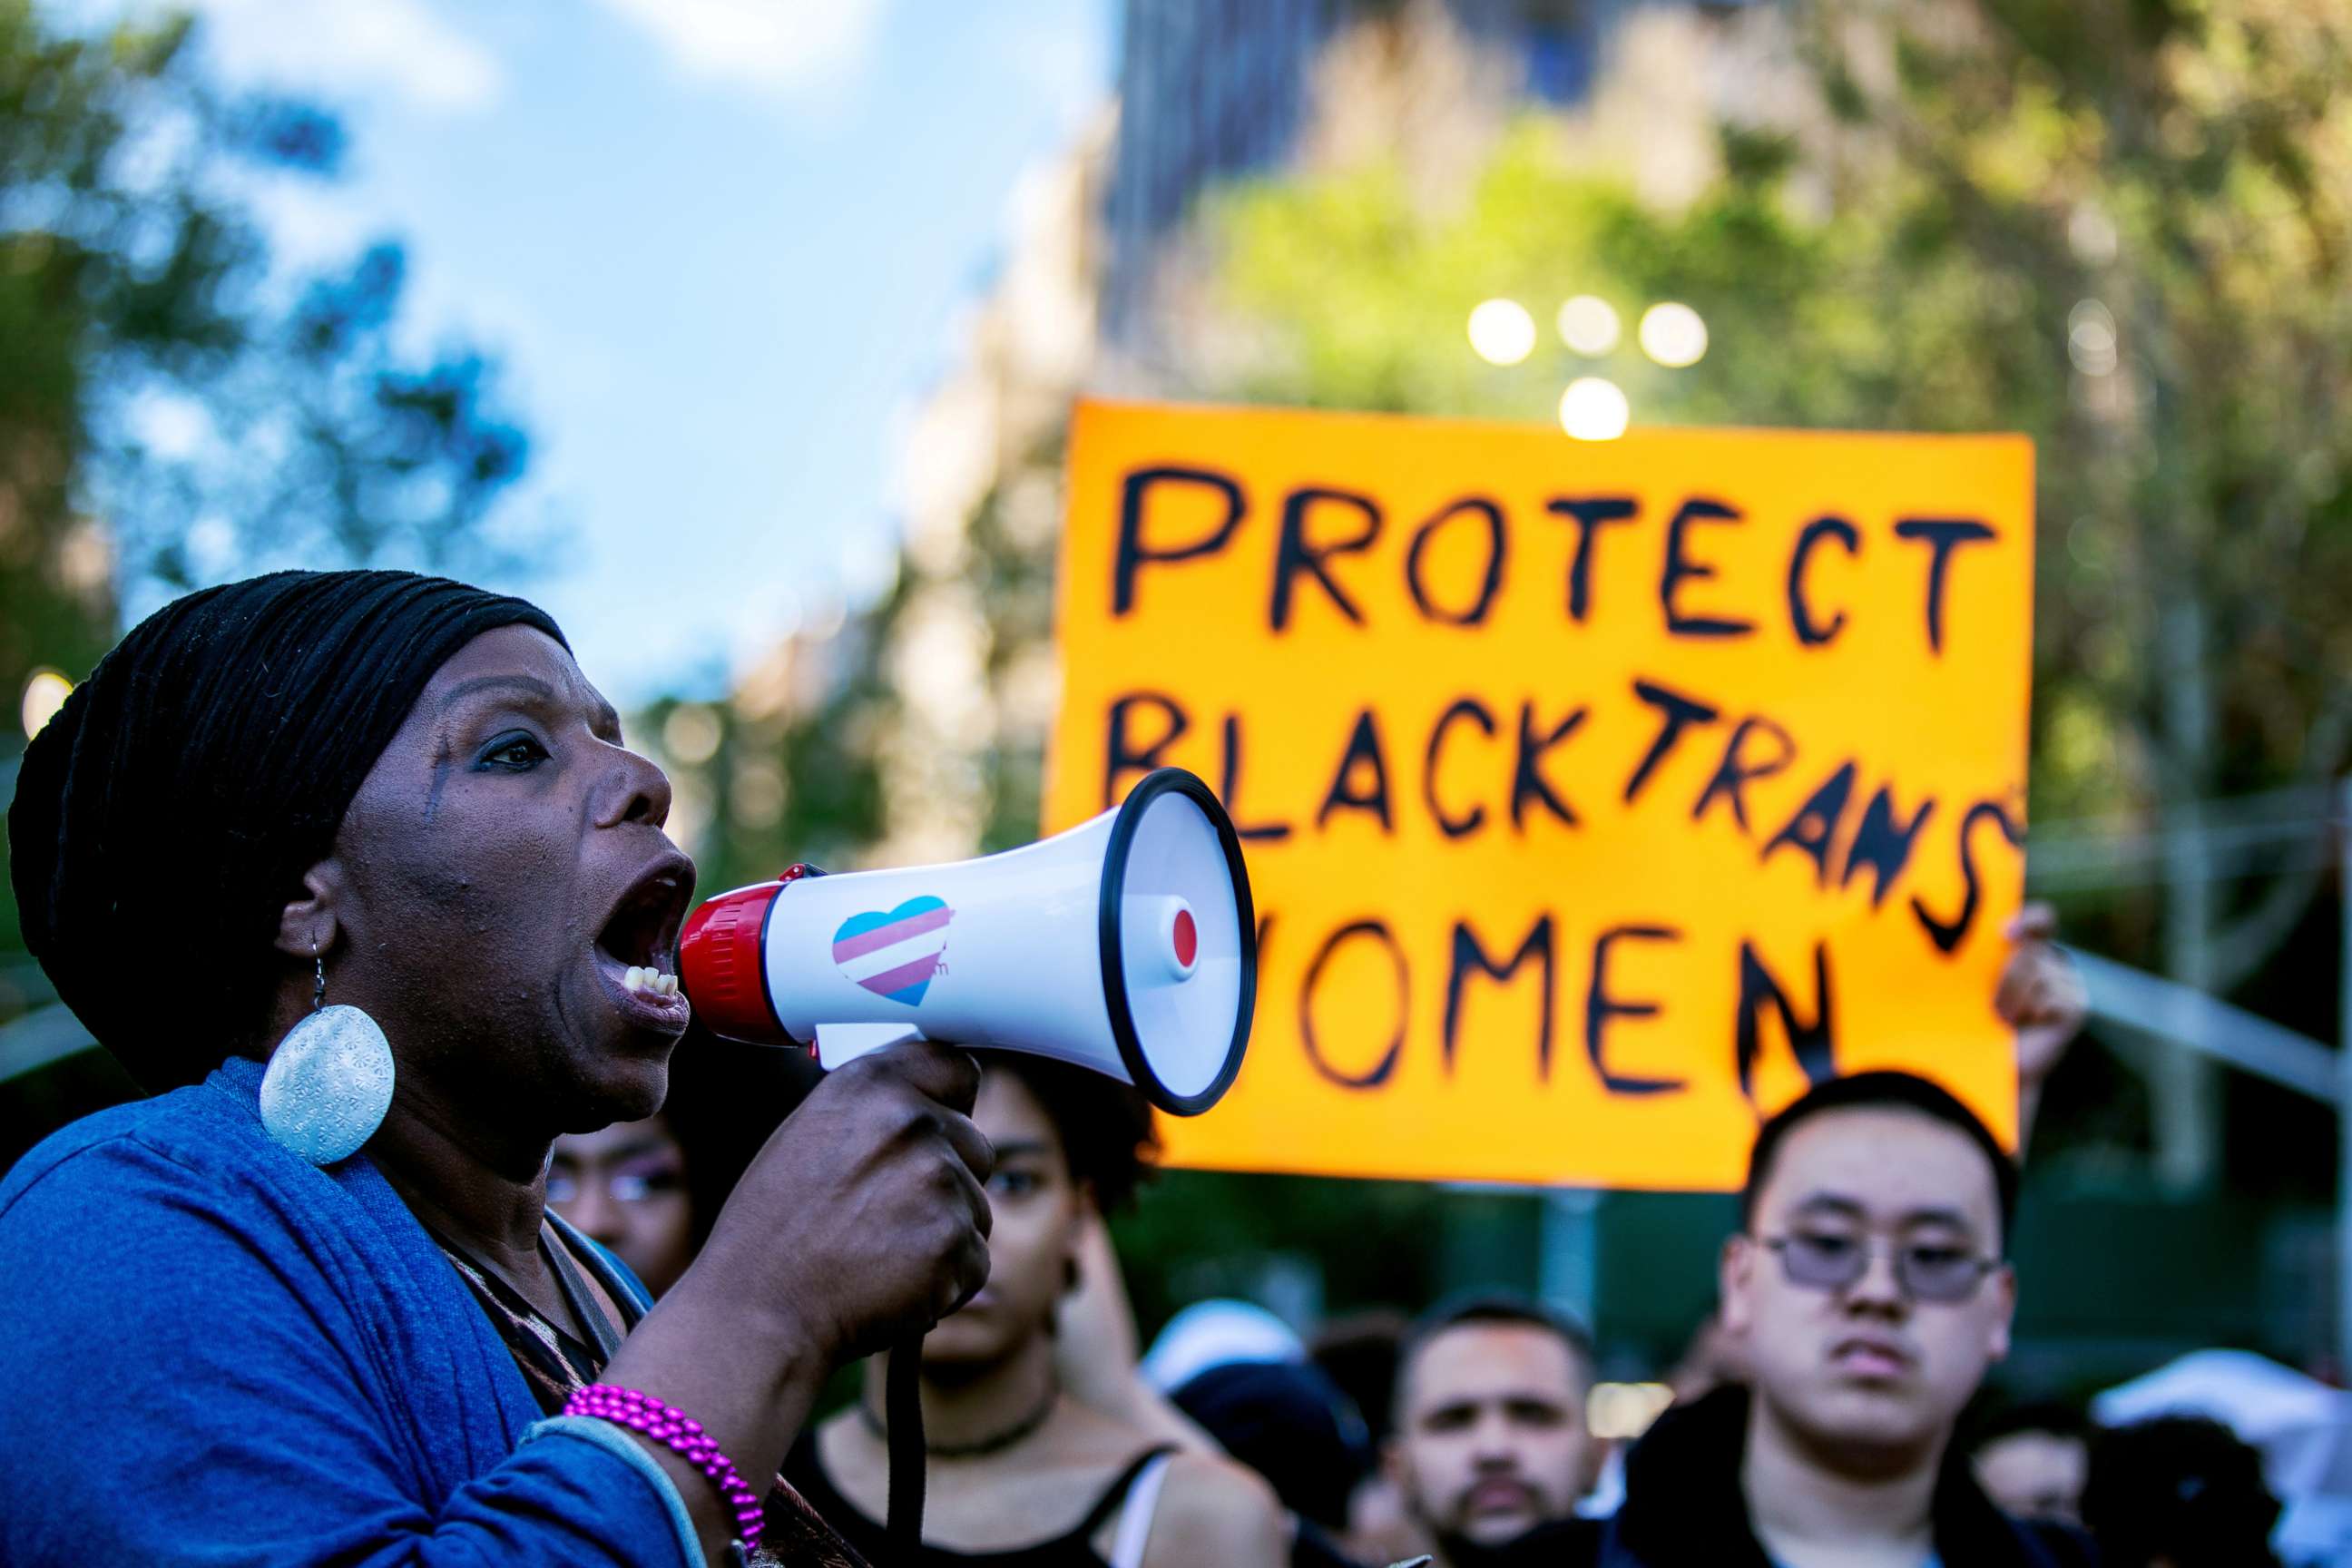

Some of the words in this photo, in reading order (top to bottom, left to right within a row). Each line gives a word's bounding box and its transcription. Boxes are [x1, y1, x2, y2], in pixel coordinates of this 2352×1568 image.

[1112, 466, 1997, 655] PROTECT
[1105, 693, 1590, 838] BLACK
[1624, 679, 2025, 953] TRANS
[1254, 912, 1837, 1105] OMEN
